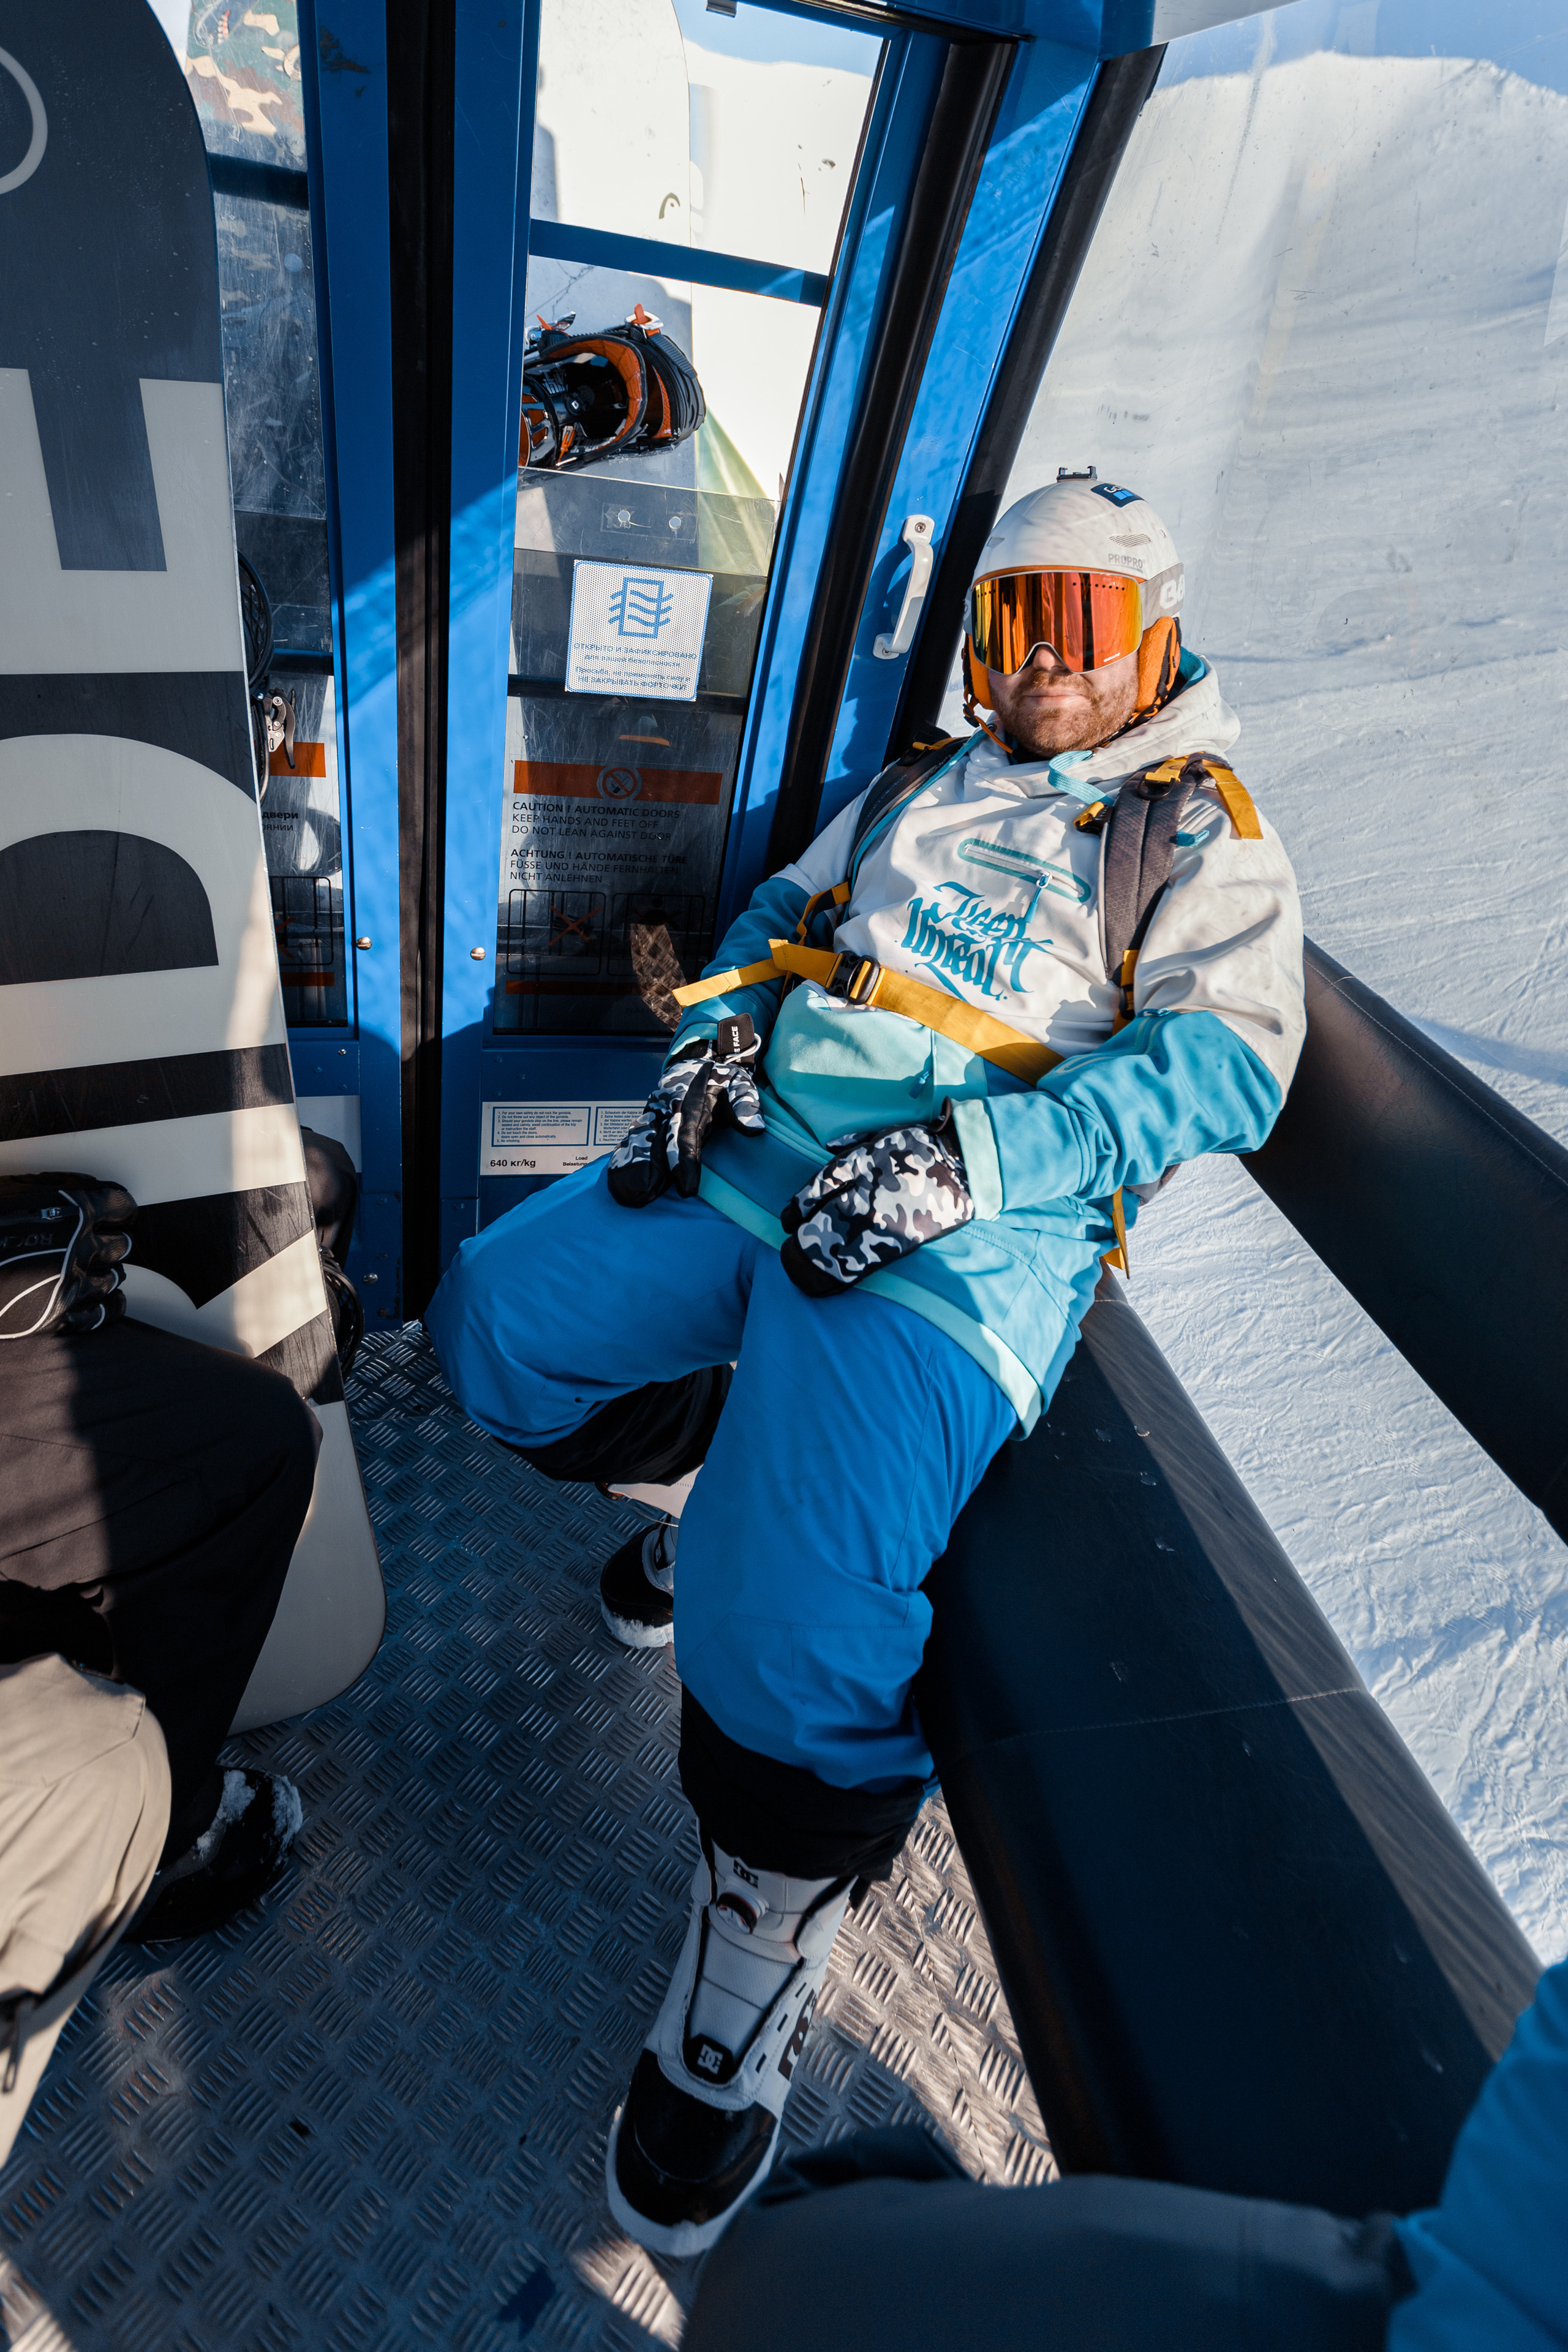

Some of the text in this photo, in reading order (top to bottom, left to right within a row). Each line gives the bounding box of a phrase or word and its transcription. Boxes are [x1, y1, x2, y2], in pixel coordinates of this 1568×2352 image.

[574, 643, 613, 652] ОТКРЫТО
[624, 647, 697, 660] ЗАФИКСИРОВАНО
[590, 676, 639, 686] ЗАКРЫВАТЬ
[513, 801, 564, 813] CAUTION
[575, 805, 639, 817] AUTOMATIC
[642, 809, 680, 818] DOORS
[513, 813, 659, 829] KEEP HANDS AND FEET OFF
[512, 825, 671, 841] DO NOT LEAN AGAINST DOOR
[511, 849, 565, 859] ACHTUNG
[576, 851, 658, 863] AUTOMATISCHE
[662, 854, 687, 864] TÜRE
[510, 859, 679, 875] FÜSSE UND HÄNDE FERNHALTEN
[510, 872, 603, 883] NICHT ANLEHNEN
[731, 1025, 741, 1047] FACE
